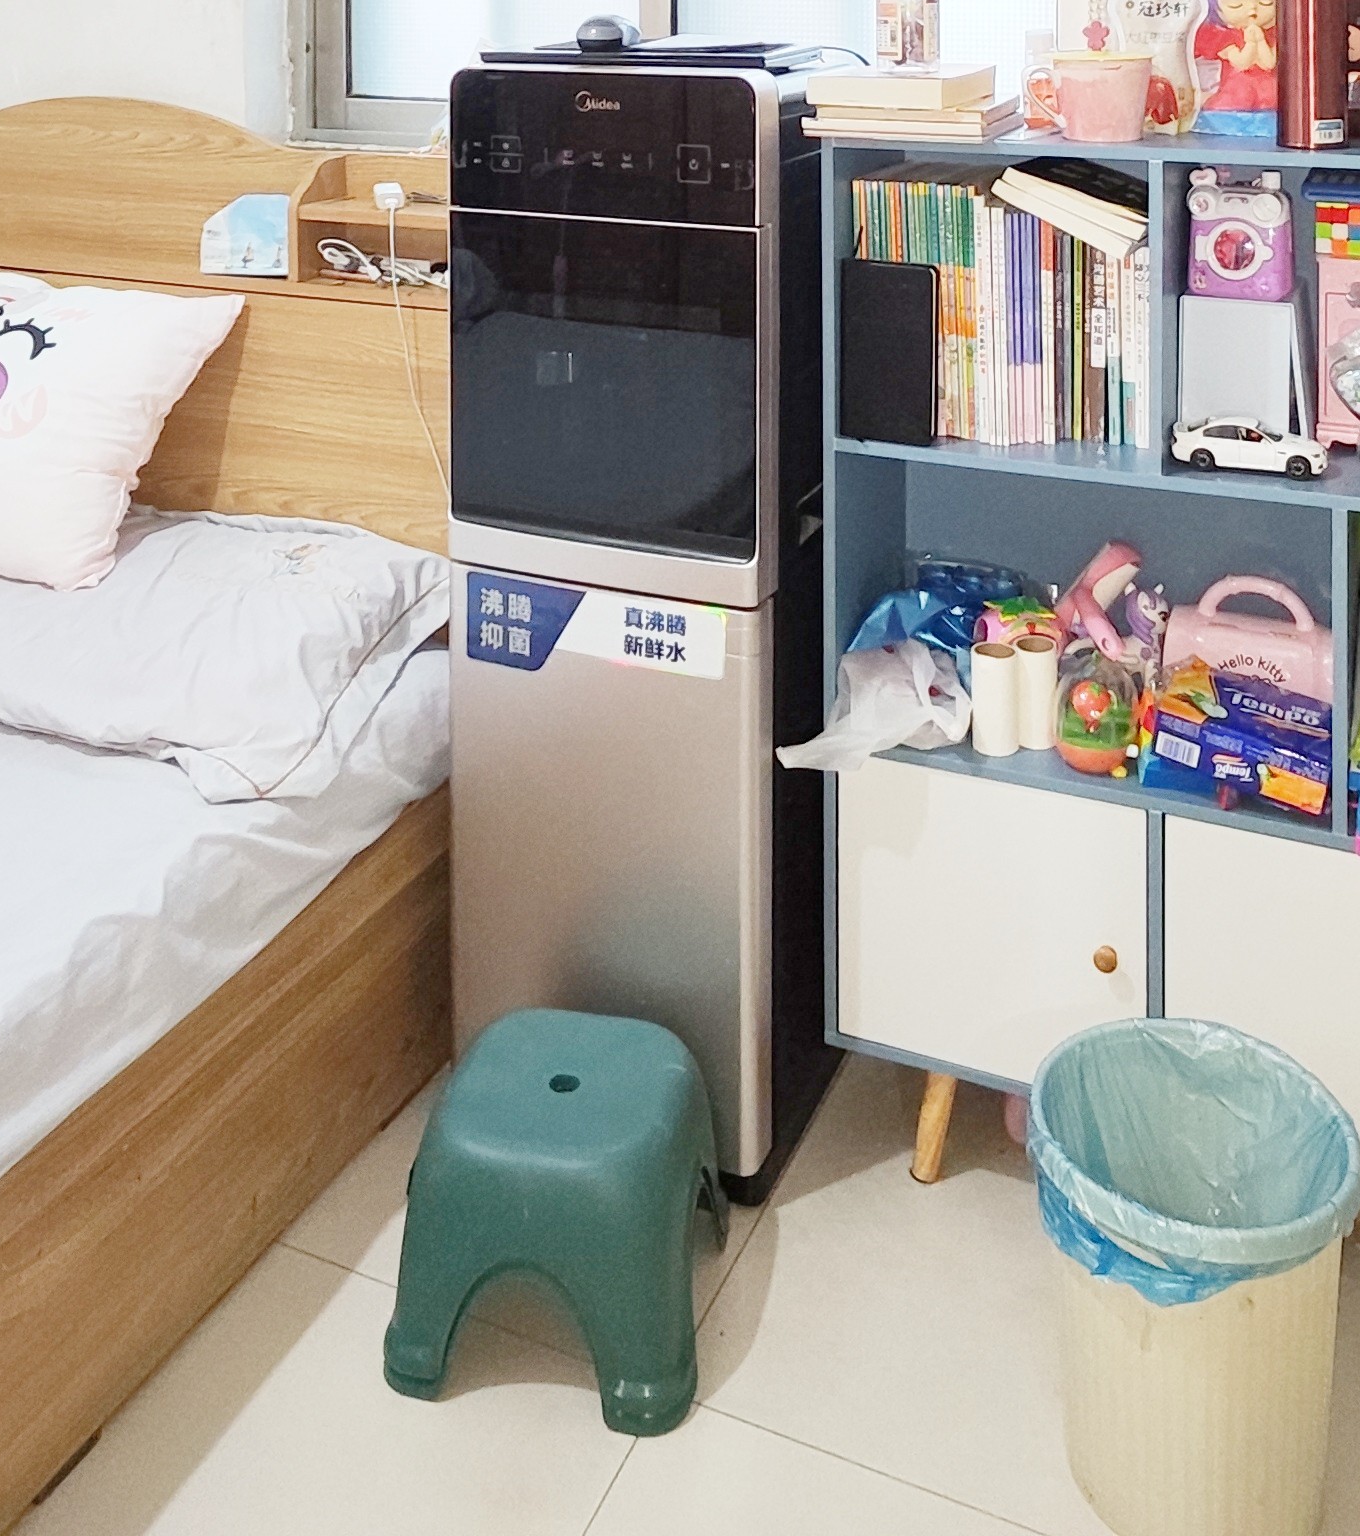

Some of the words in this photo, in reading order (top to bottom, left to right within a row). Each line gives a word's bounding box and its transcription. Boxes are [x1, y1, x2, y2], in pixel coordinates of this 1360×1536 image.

[1137, 0, 1189, 18] 冠珍轩
[575, 90, 621, 112] Midea
[480, 587, 533, 623] 沸腾
[624, 606, 687, 637] 真沸腾
[479, 621, 532, 657] 抑菌
[624, 634, 687, 663] 新鲜水
[1217, 654, 1254, 671] Hello
[1223, 687, 1321, 727] Tempo
